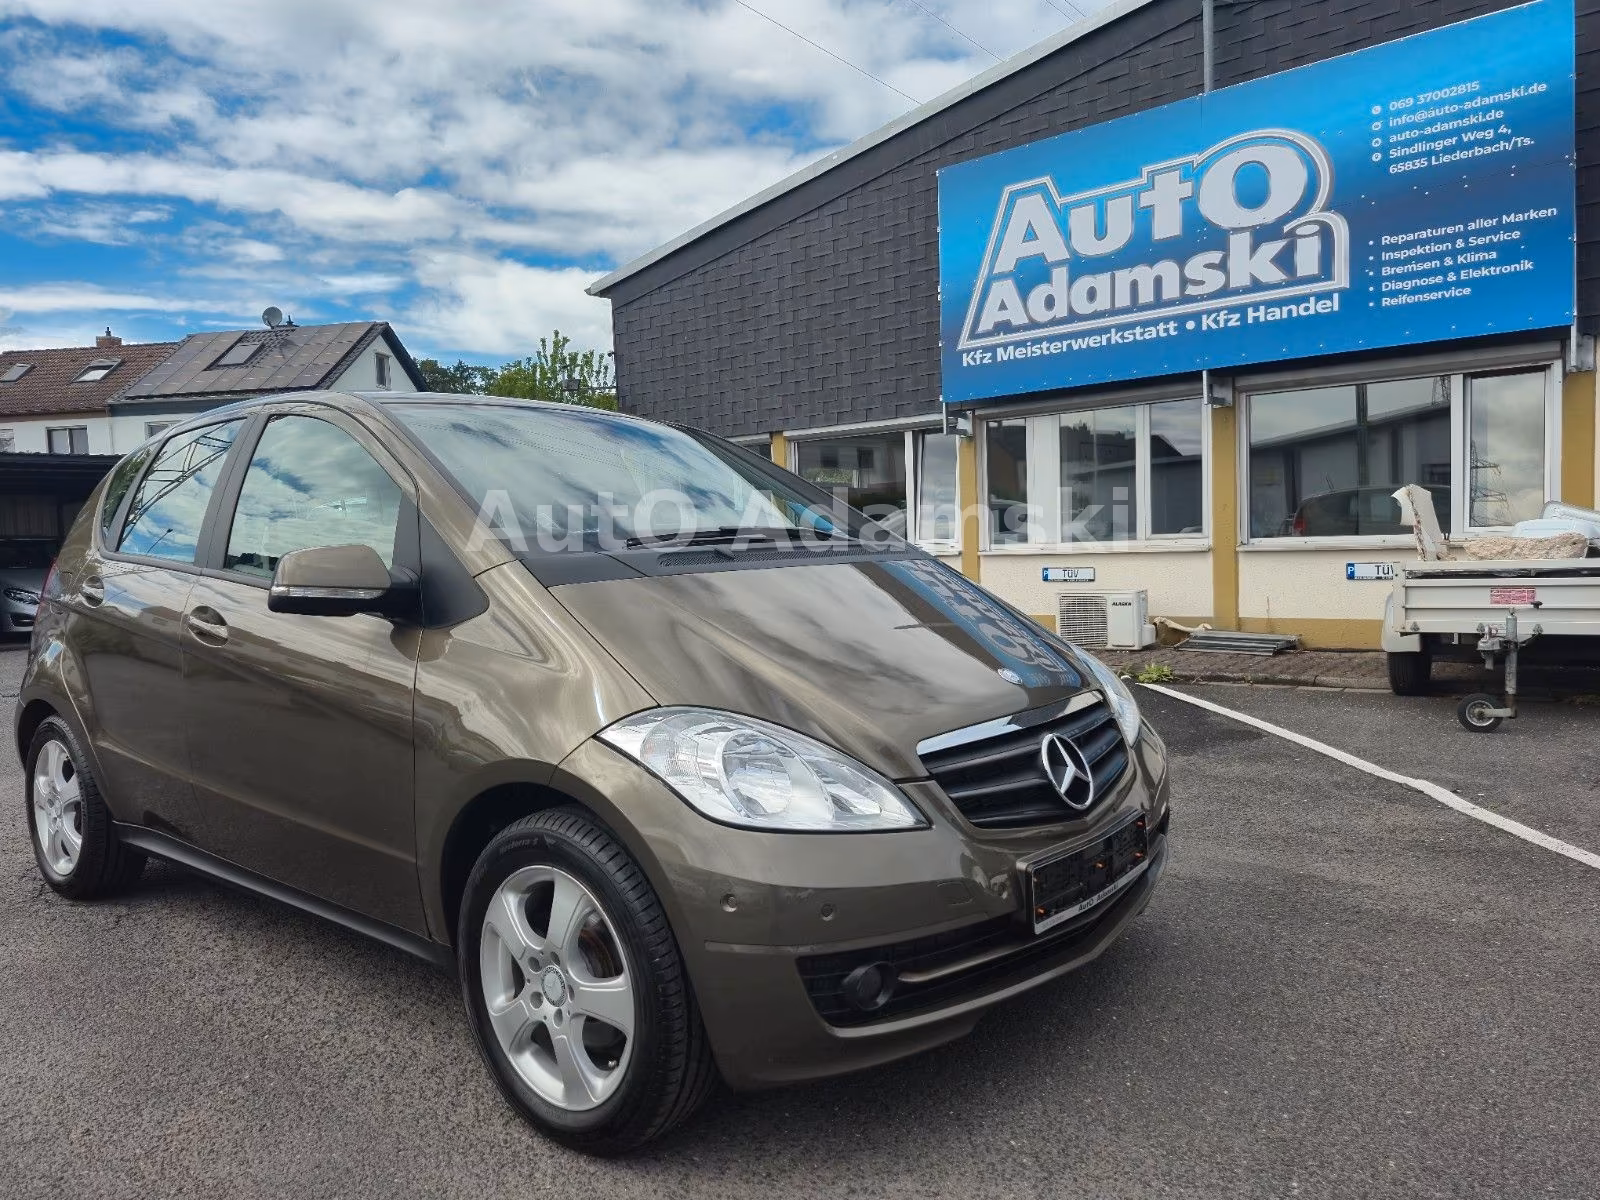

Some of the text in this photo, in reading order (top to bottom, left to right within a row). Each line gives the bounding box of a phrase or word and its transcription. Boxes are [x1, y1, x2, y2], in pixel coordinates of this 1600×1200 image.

[1389, 81, 1480, 111] 069 37002815
[1389, 82, 1547, 127] info@auto-adamski.de
[1389, 108, 1504, 143] auto-adamski.de
[1389, 123, 1512, 159] Sindlinger Weg 4,
[1389, 137, 1535, 174] 65835 Liederbach/Ts.
[1381, 207, 1558, 246] Reparaturen aller Marken
[1381, 229, 1521, 262] Inspektion & Service
[976, 224, 1322, 334] Adamski
[1381, 250, 1497, 277] Bremsen & Klima
[1381, 259, 1534, 293] Diagnose & Elektronik
[1381, 285, 1472, 308] Reifenservice
[962, 293, 1340, 367] Kfz Meisterwerkstatt Kfz Handel
[1062, 569, 1079, 578] TÜV
